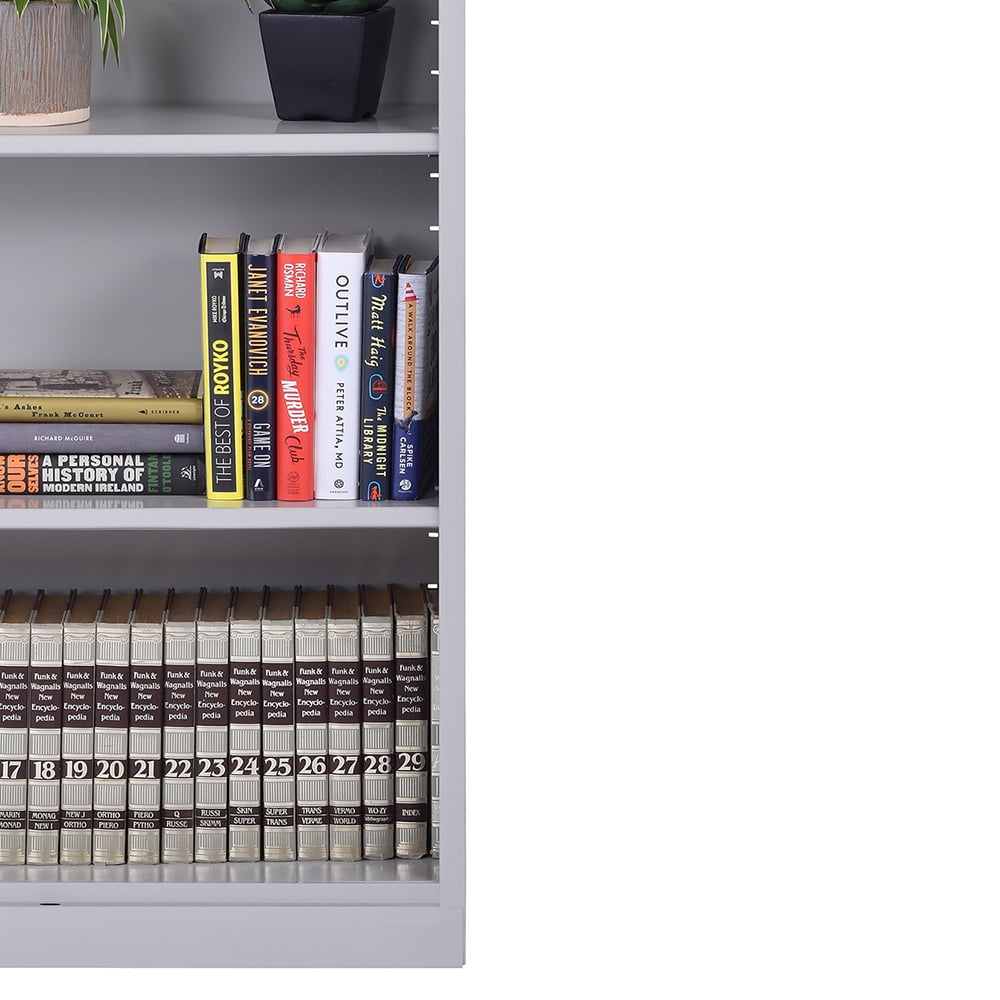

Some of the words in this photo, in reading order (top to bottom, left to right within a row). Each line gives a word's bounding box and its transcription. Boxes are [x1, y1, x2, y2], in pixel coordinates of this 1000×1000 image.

[248, 264, 267, 302] JANET
[283, 263, 294, 297] OSMAN
[335, 275, 350, 348] OUTLIVE
[371, 294, 388, 330] Matt
[248, 308, 268, 376] EVANOVICH
[283, 326, 303, 377] Thursday
[298, 347, 307, 360] The
[364, 336, 387, 367] Haig
[212, 339, 230, 395] ROYKO
[251, 396, 265, 405] 28
[336, 382, 345, 411] PETER
[214, 399, 231, 418] OF
[281, 380, 309, 434] MURDER
[376, 406, 387, 421] The
[215, 421, 232, 454] BEST
[253, 423, 271, 451] GAME
[363, 418, 374, 465] LIBRARY
[285, 435, 305, 465] Club
[376, 424, 387, 477] MIDNIGHT
[399, 436, 407, 475] CARLSEN
[406, 444, 414, 468] SPIKE
[42, 455, 52, 467] A
[57, 455, 144, 467] PERSONAL
[253, 454, 271, 468] ON
[334, 452, 344, 469] MD
[7, 455, 26, 493] OUR
[27, 455, 39, 493] SELVES
[42, 468, 121, 482] HISTORY
[123, 468, 145, 482] OF
[147, 455, 159, 493] FINTAN
[215, 458, 232, 484] THE
[42, 483, 92, 493] MODERN
[95, 483, 144, 493] IRELAND
[31, 683, 61, 691] Wagnalls
[296, 678, 326, 687] Wagnalls
[1, 761, 21, 779] 17
[34, 761, 55, 779] 18
[65, 761, 87, 778] 19
[96, 761, 124, 779] 20
[134, 760, 155, 778] 21
[165, 760, 191, 777] 22
[199, 759, 225, 777] 23
[231, 757, 259, 775] 24
[264, 758, 291, 776] 25
[299, 756, 326, 774] 26
[333, 756, 358, 774] 27
[365, 756, 390, 774] 28
[399, 753, 425, 770] 29
[265, 808, 287, 816] SUPER
